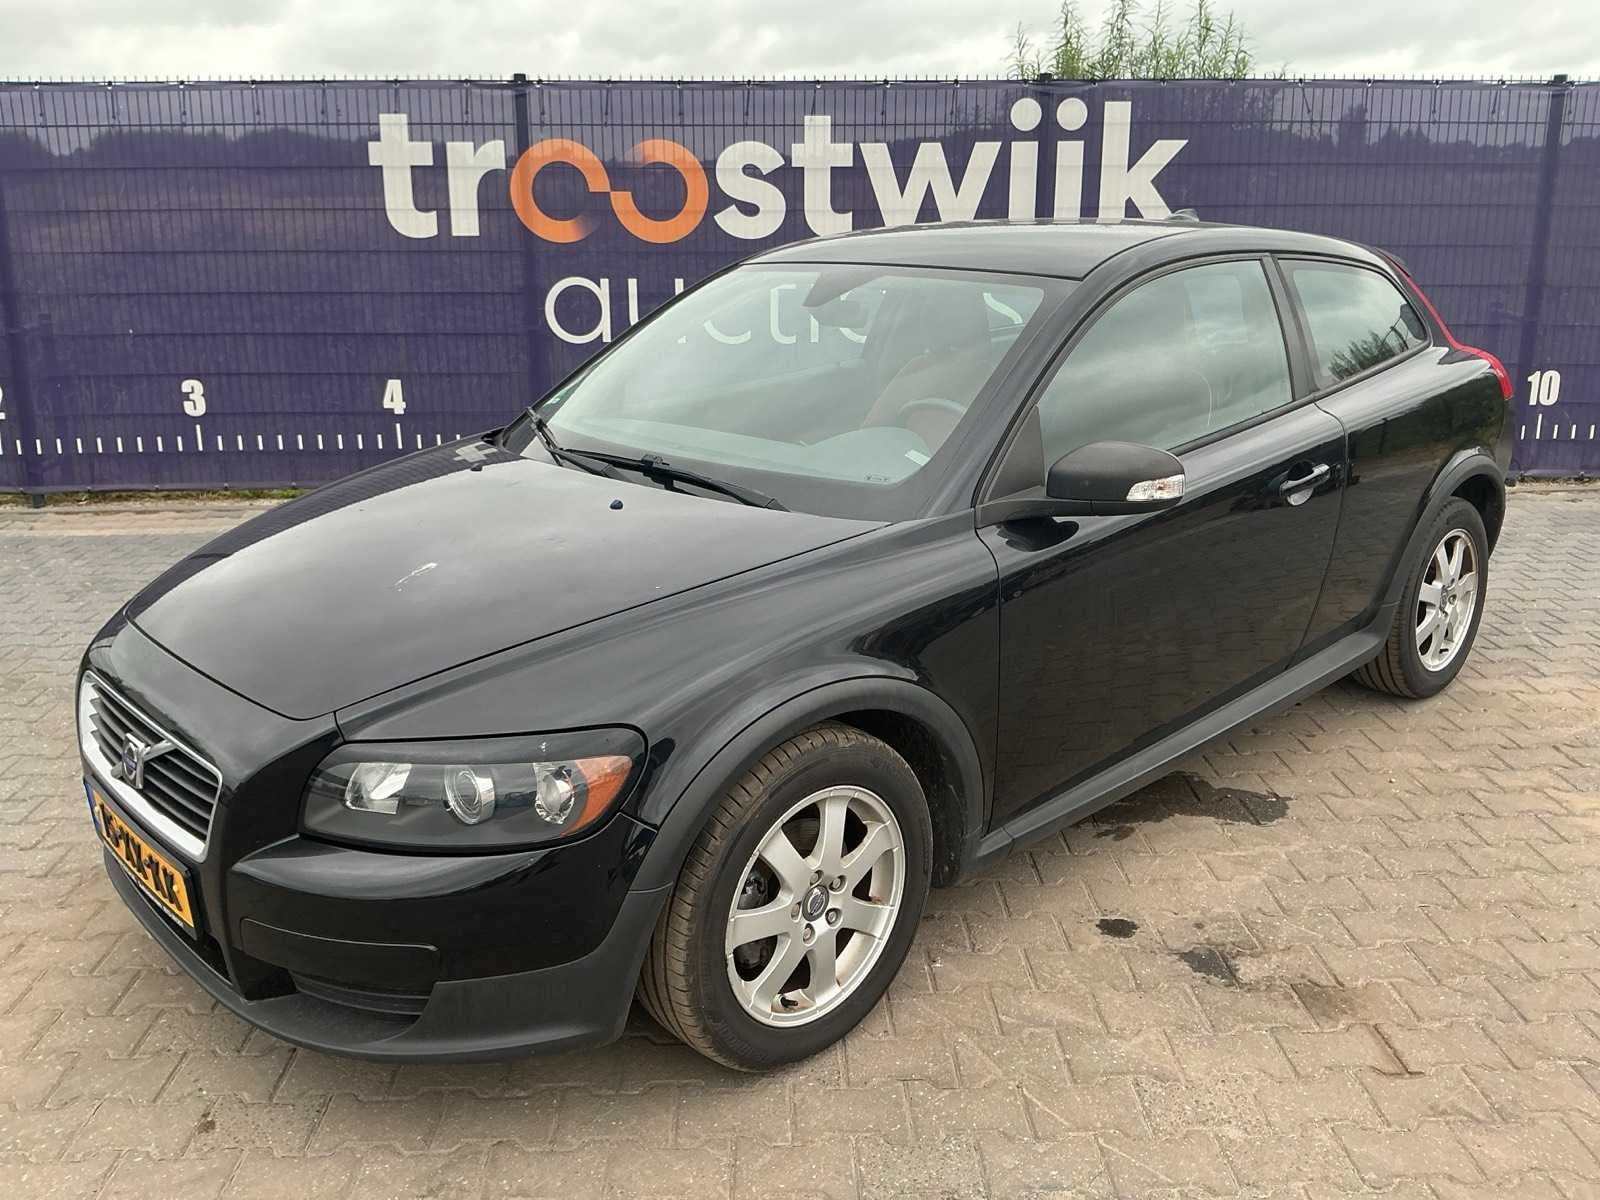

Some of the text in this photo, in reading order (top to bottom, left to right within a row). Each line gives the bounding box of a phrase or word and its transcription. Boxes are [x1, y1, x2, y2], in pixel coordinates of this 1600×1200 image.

[181, 379, 207, 417] 3
[382, 379, 406, 414] 4
[1527, 370, 1561, 406] 10
